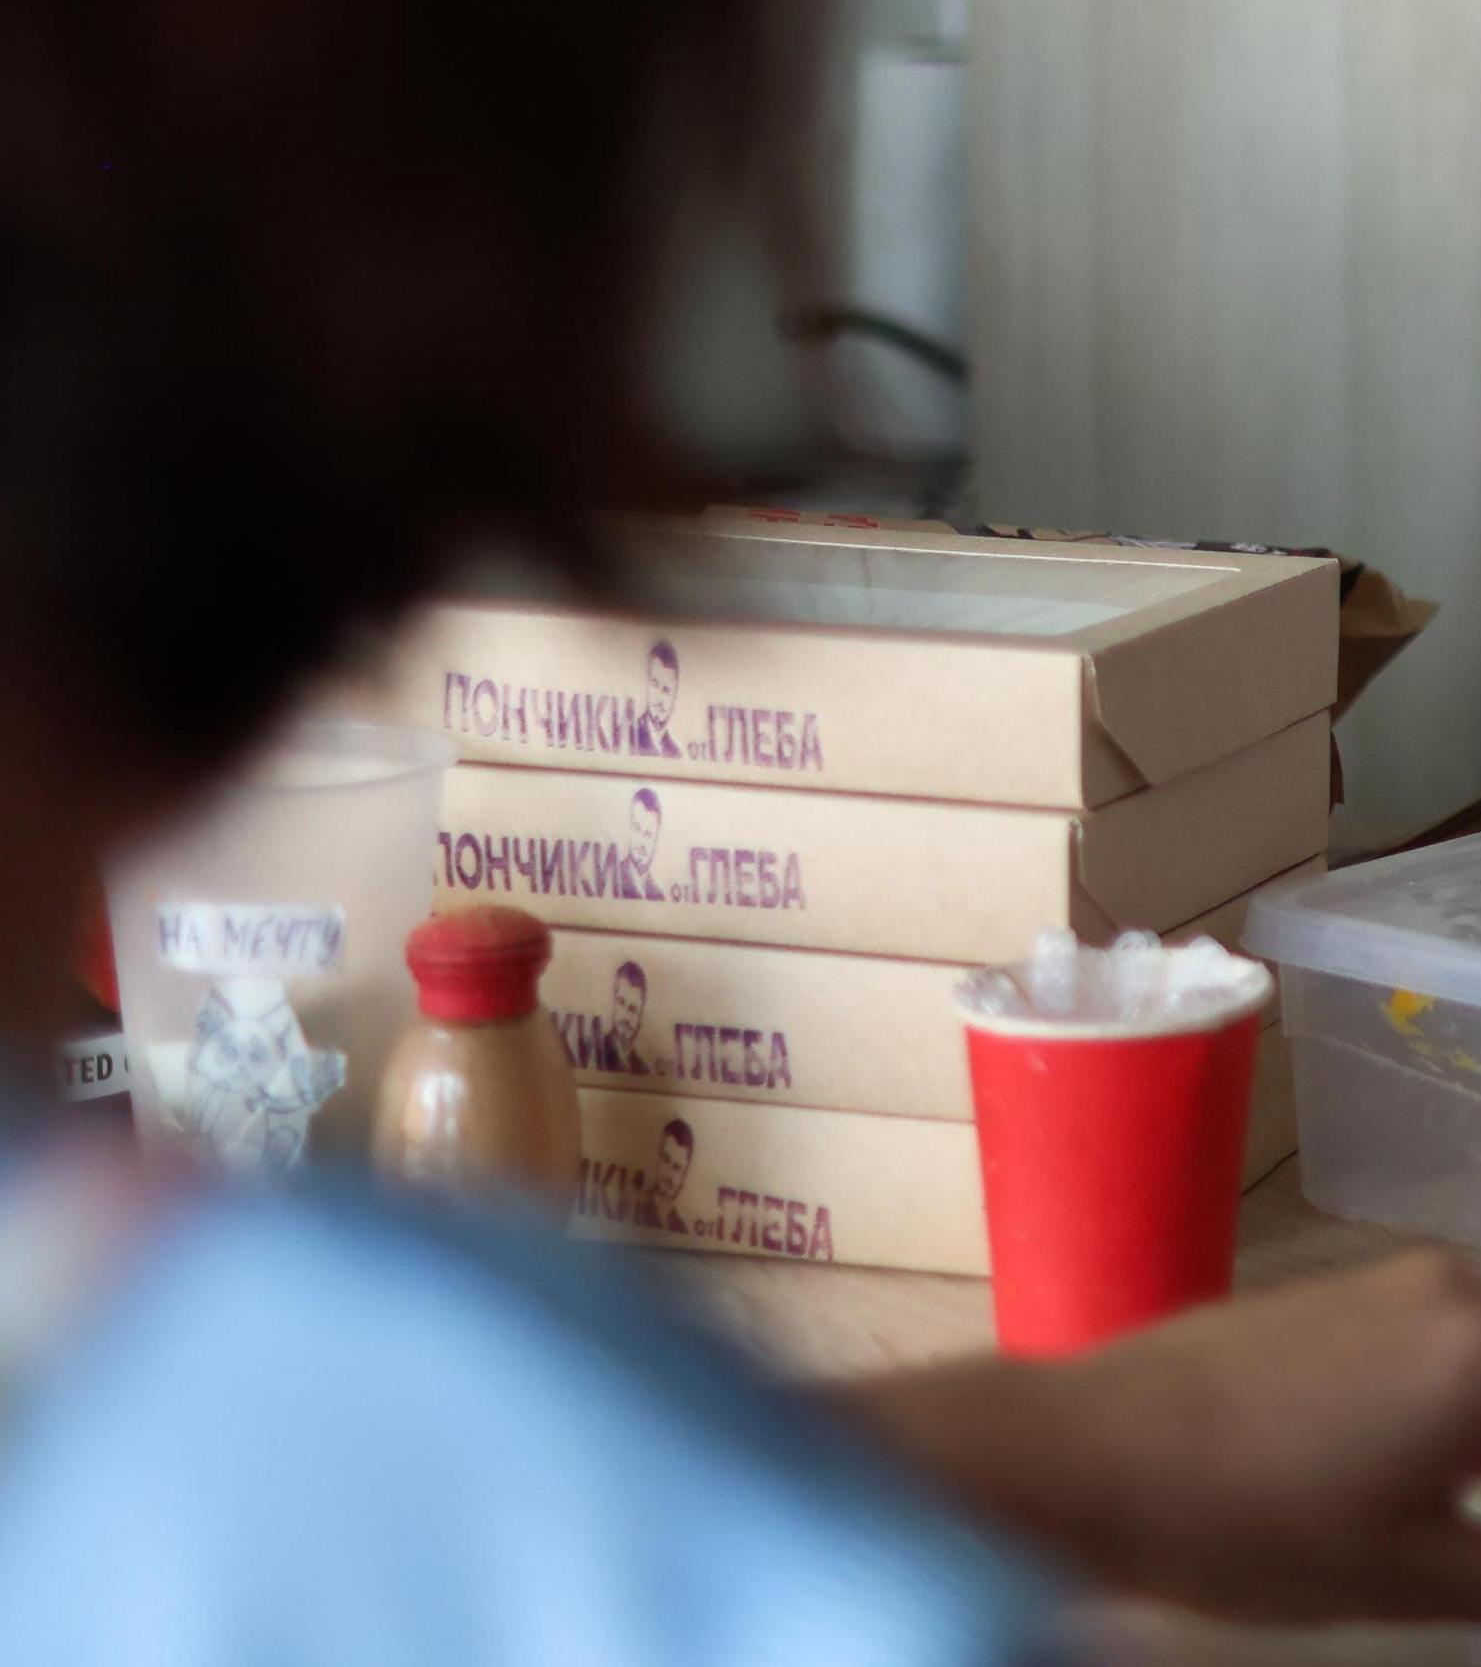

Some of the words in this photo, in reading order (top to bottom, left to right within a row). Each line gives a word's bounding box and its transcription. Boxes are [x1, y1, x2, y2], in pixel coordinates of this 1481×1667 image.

[443, 672, 637, 755] ПОНЧИКИ
[708, 704, 824, 772] ГЛЕБА
[690, 846, 806, 911] ГЛЕБА
[674, 1022, 791, 1088] ГЛЕБА
[717, 1186, 834, 1262] ГЛЕБА
